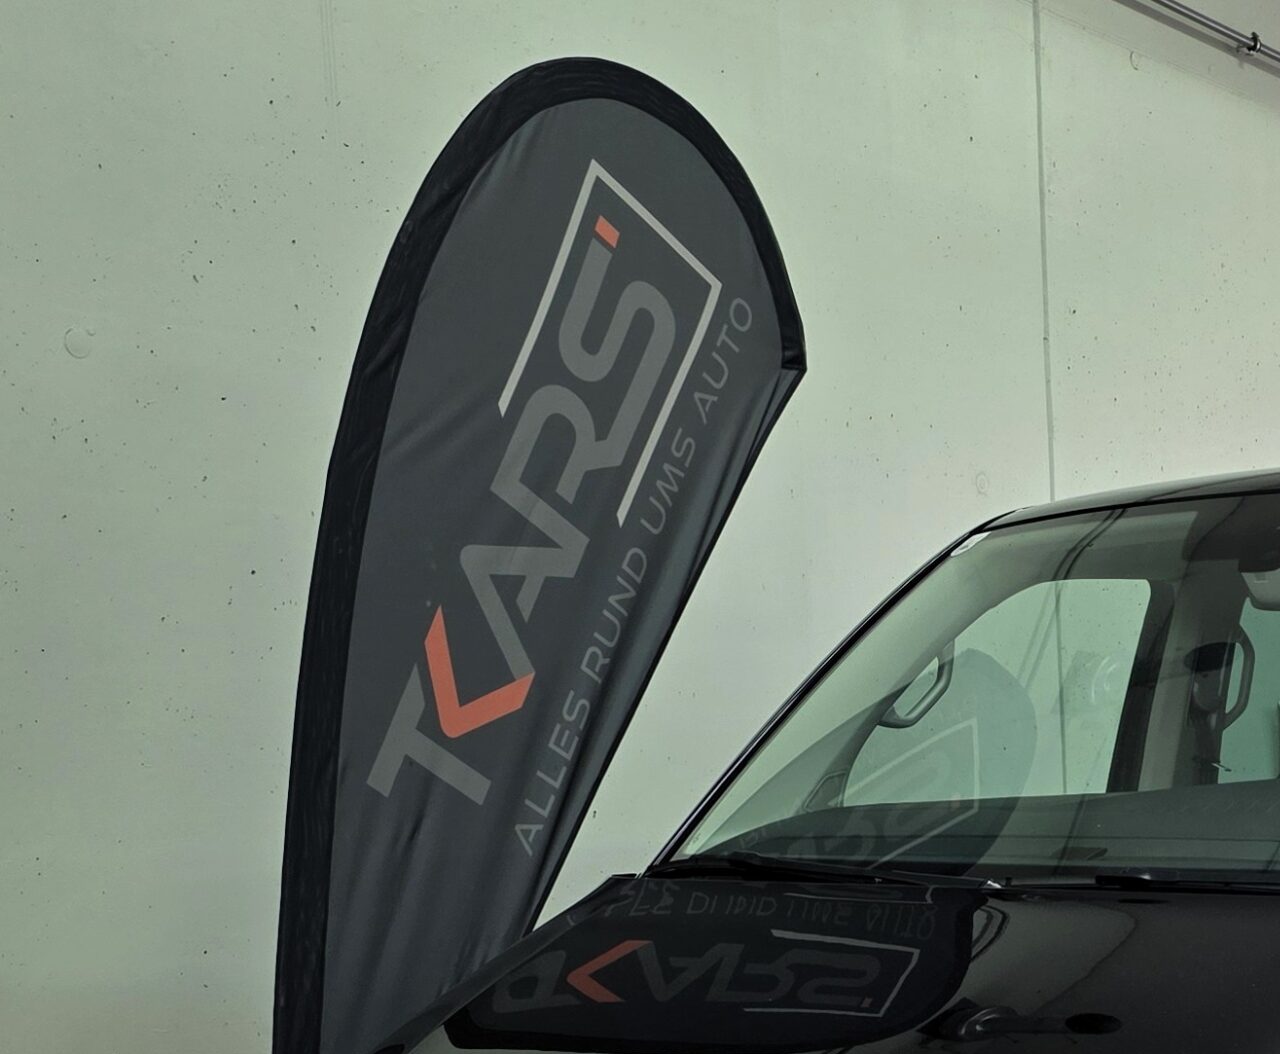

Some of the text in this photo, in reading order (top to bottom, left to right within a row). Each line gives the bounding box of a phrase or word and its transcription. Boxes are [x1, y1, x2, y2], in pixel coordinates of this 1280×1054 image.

[514, 297, 753, 857] ALLES RUND UMS AUTO
